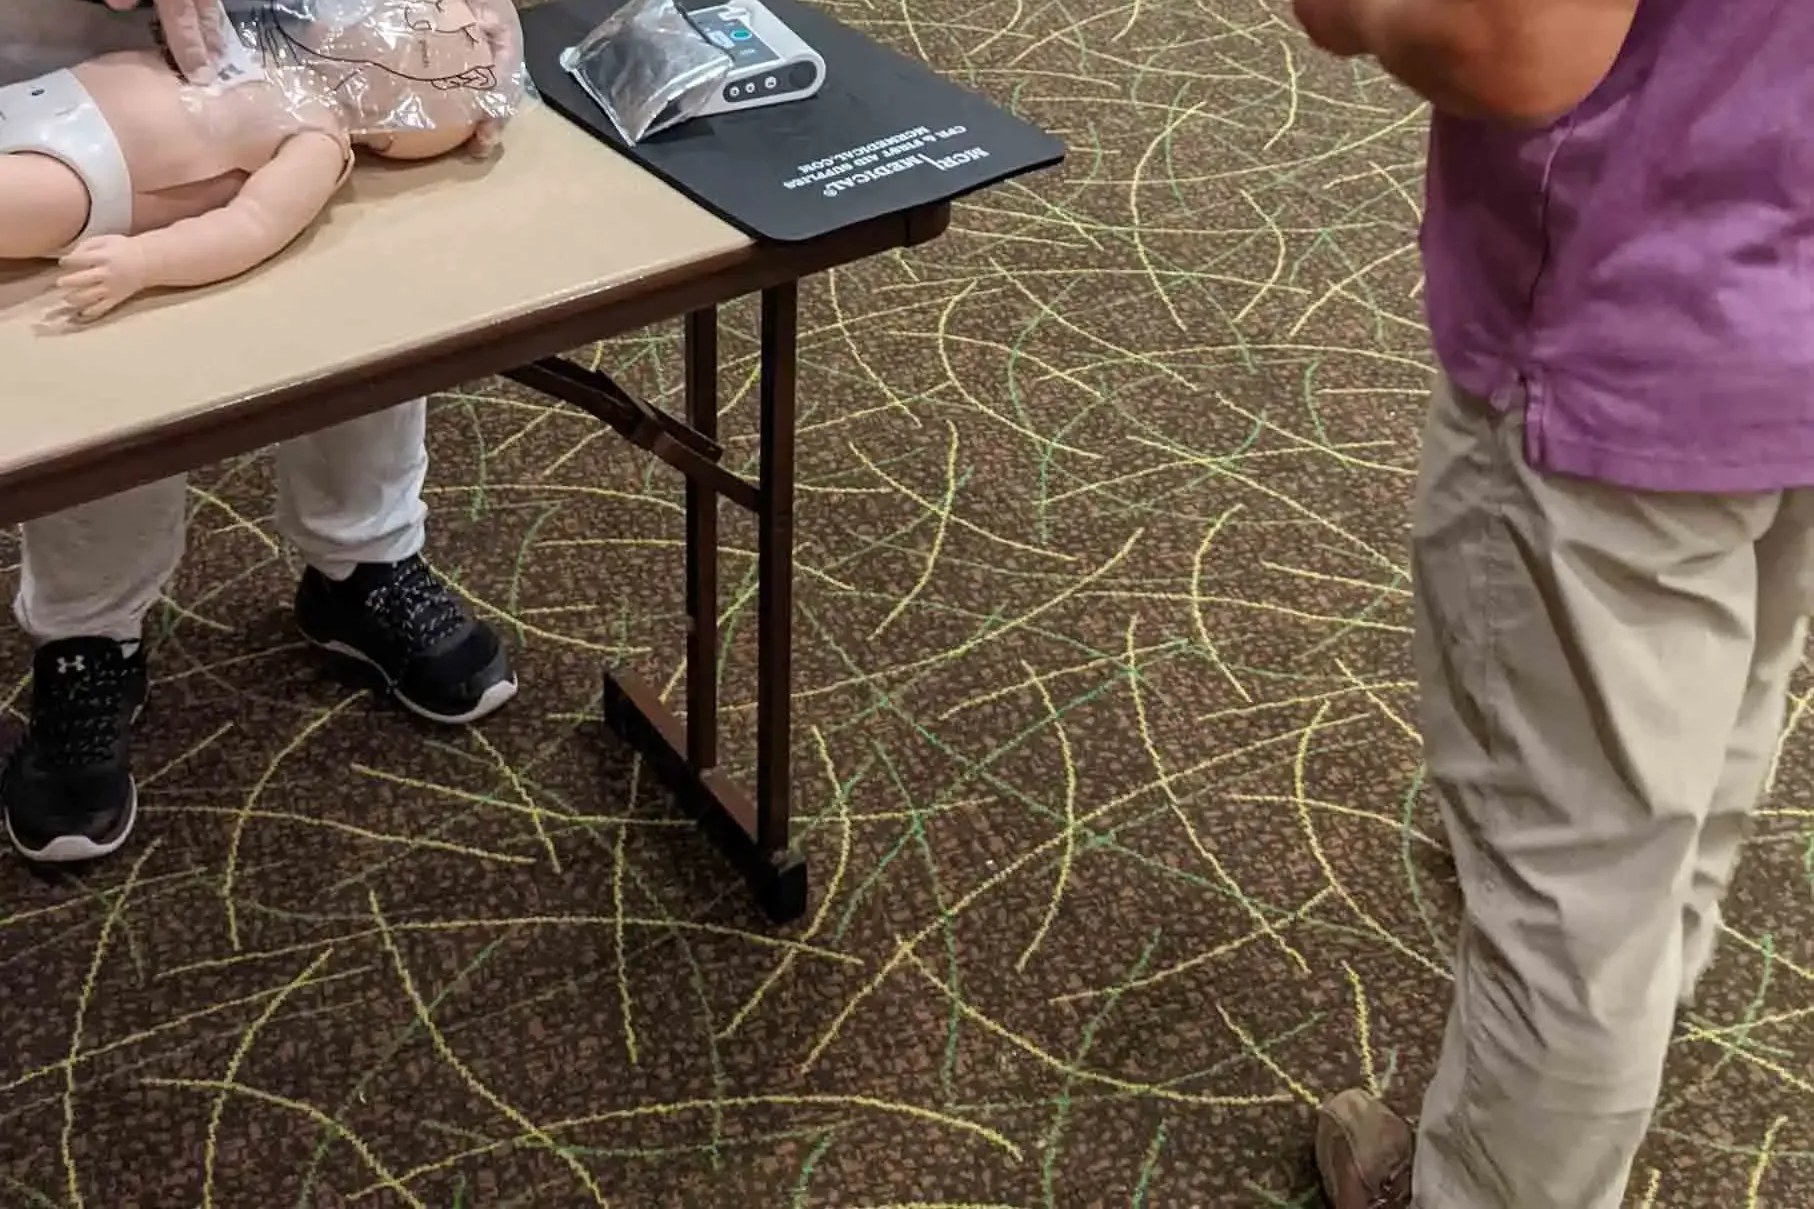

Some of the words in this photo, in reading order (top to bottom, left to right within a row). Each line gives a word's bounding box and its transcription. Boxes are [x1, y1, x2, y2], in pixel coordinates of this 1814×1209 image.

[935, 125, 967, 139] CPR
[882, 139, 924, 158] FIRST
[853, 153, 879, 166] AID
[935, 147, 990, 168] MCR
